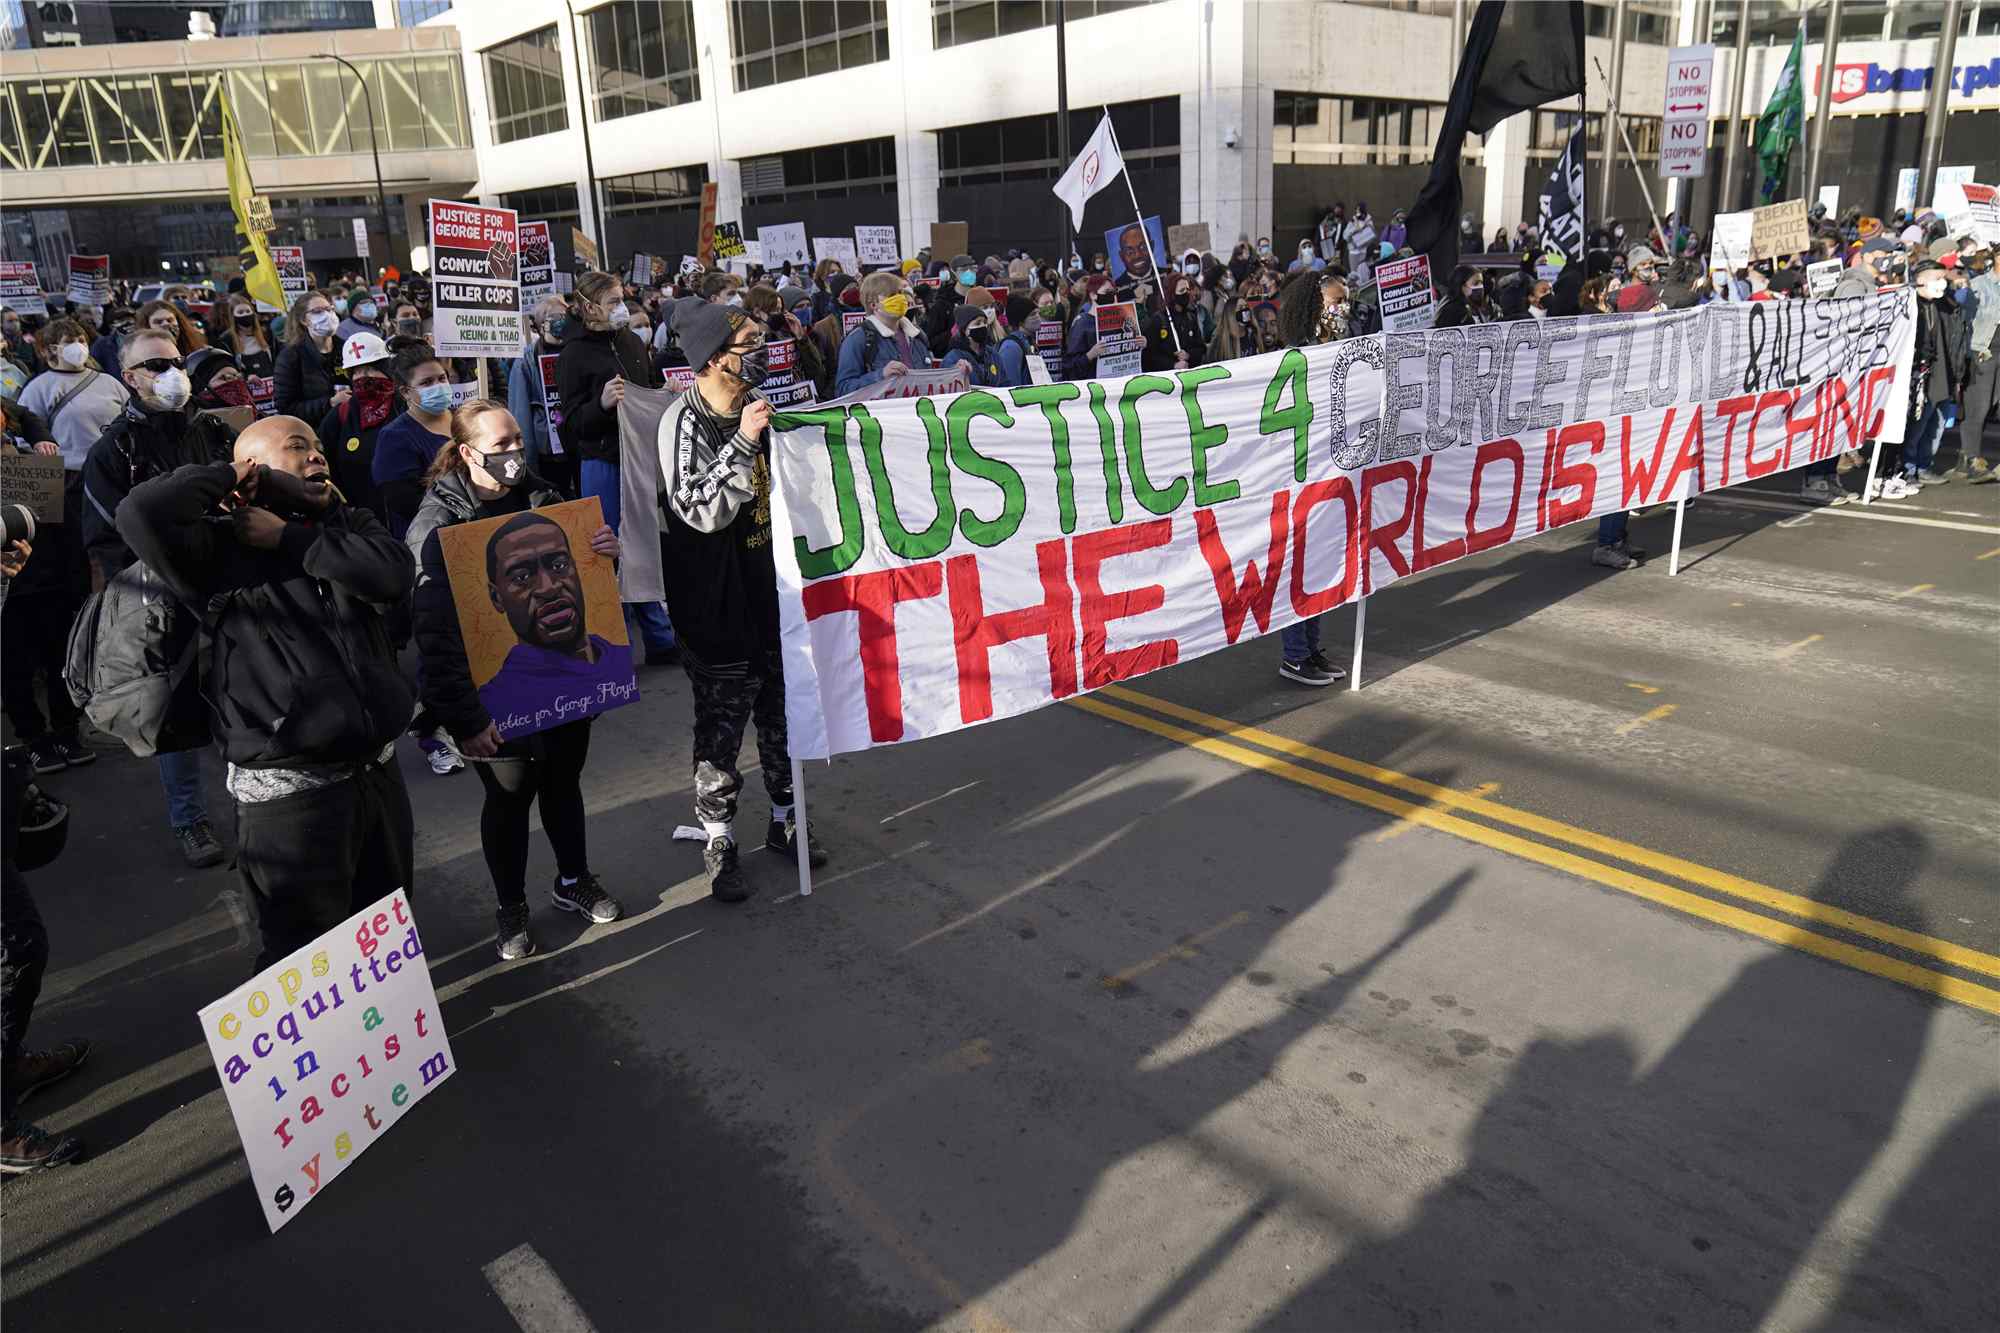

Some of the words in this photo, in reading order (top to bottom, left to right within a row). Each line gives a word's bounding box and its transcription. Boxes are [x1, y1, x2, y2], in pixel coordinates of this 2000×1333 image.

[1679, 67, 1701, 81] NO
[1669, 85, 1707, 97] STOPPING
[1671, 122, 1697, 140] NO
[1663, 146, 1703, 159] STOPPING
[436, 208, 481, 225] JUSTICE
[484, 214, 503, 227] FOR
[1754, 202, 1804, 222] IBERTY
[436, 223, 480, 240] GEORGE
[484, 228, 514, 243] FLOYD
[520, 227, 536, 236] FOR
[868, 228, 894, 237] SYSTEM
[1756, 218, 1805, 239] JUSTICE
[520, 235, 547, 245] FLOYD
[1775, 236, 1802, 253] ALL
[720, 244, 746, 258] MORE
[439, 257, 490, 274] CONVICT
[1379, 263, 1406, 276] JUSTICE
[282, 281, 301, 289] COPS
[524, 271, 547, 282] COPS
[440, 285, 481, 302] KILLER
[485, 287, 513, 305] COPS
[1383, 285, 1413, 299] CONVICT
[1384, 300, 1409, 313] KILLER
[1410, 295, 1428, 306] COPS
[460, 330, 489, 341] KEUNG
[491, 331, 496, 341] &
[499, 331, 519, 341] THAO
[1331, 353, 1345, 390] QUINN
[768, 391, 791, 405] LLER
[792, 388, 809, 401] COPS
[770, 365, 1241, 580] JUSTICE
[1259, 349, 1314, 483] 4
[1330, 317, 1578, 471] GEORGE
[1574, 300, 1741, 424] FLOYD
[1743, 302, 1767, 394] &
[1765, 299, 1811, 391] ALL
[801, 517, 1179, 743] THE
[1193, 438, 1525, 646] WORLD
[1536, 420, 1606, 533] IS
[1620, 364, 1898, 510] WATCHING
[535, 709, 553, 728] for
[554, 695, 594, 720] George
[597, 673, 638, 704] Floyd
[218, 950, 330, 1041] cops
[355, 896, 409, 958] get
[224, 926, 424, 1085] acquitted
[267, 1048, 321, 1102] in
[362, 1006, 384, 1032] a
[273, 1008, 429, 1150] racist
[274, 1050, 449, 1214] system
